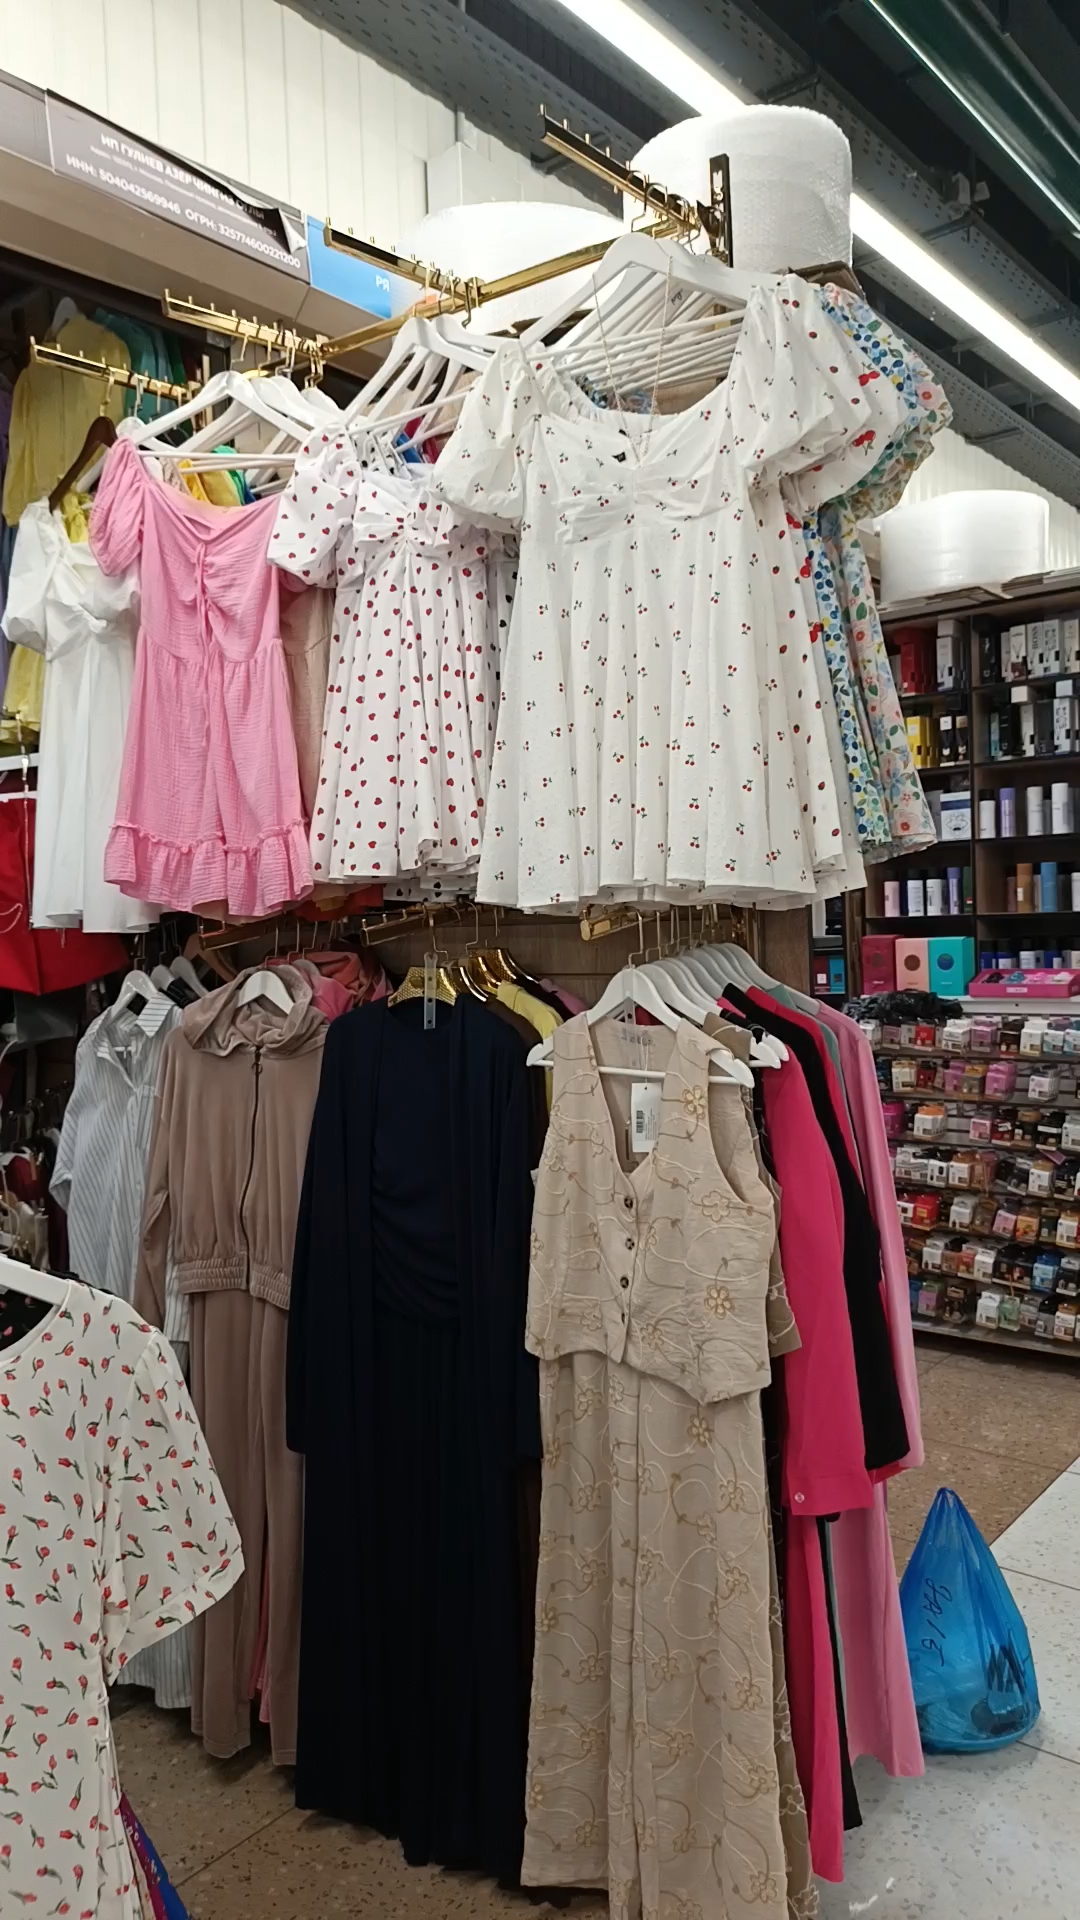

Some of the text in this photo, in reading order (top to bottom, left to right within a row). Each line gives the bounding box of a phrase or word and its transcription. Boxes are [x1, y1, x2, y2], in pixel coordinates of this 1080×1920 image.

[101, 133, 119, 152] ИП
[120, 142, 164, 173] ГУЛИЕВ
[66, 153, 301, 269] ИНН: 504042569946 ОГРН: 325774600221200
